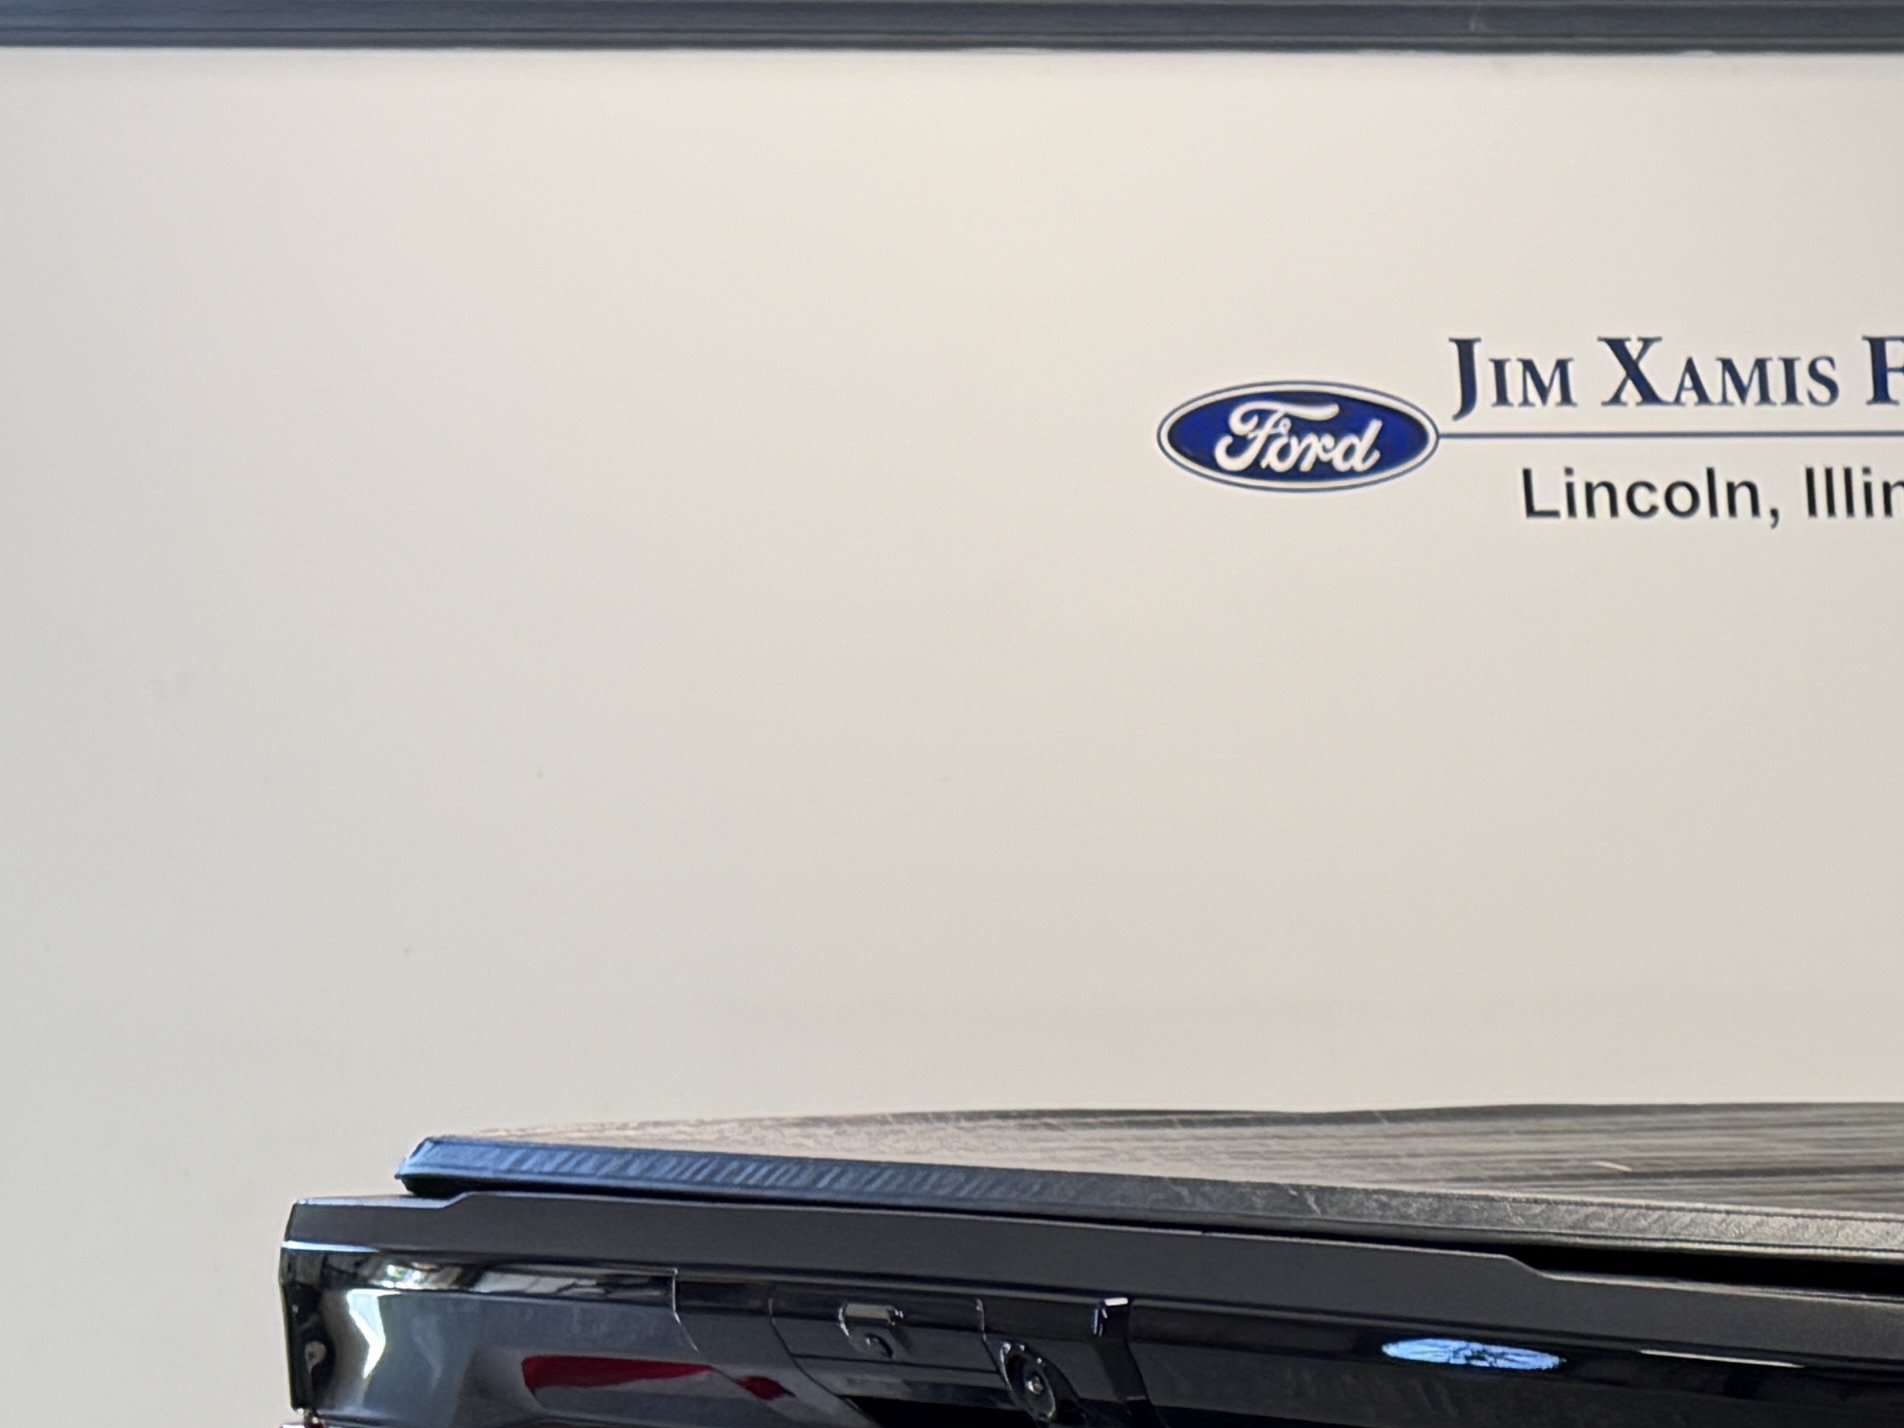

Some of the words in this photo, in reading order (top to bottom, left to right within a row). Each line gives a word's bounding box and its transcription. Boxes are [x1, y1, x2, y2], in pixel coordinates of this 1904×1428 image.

[1448, 336, 1579, 422] JIM
[1597, 336, 1841, 408] XAMIS
[1213, 399, 1384, 472] Ford
[1521, 466, 1780, 529] Lincoln,
